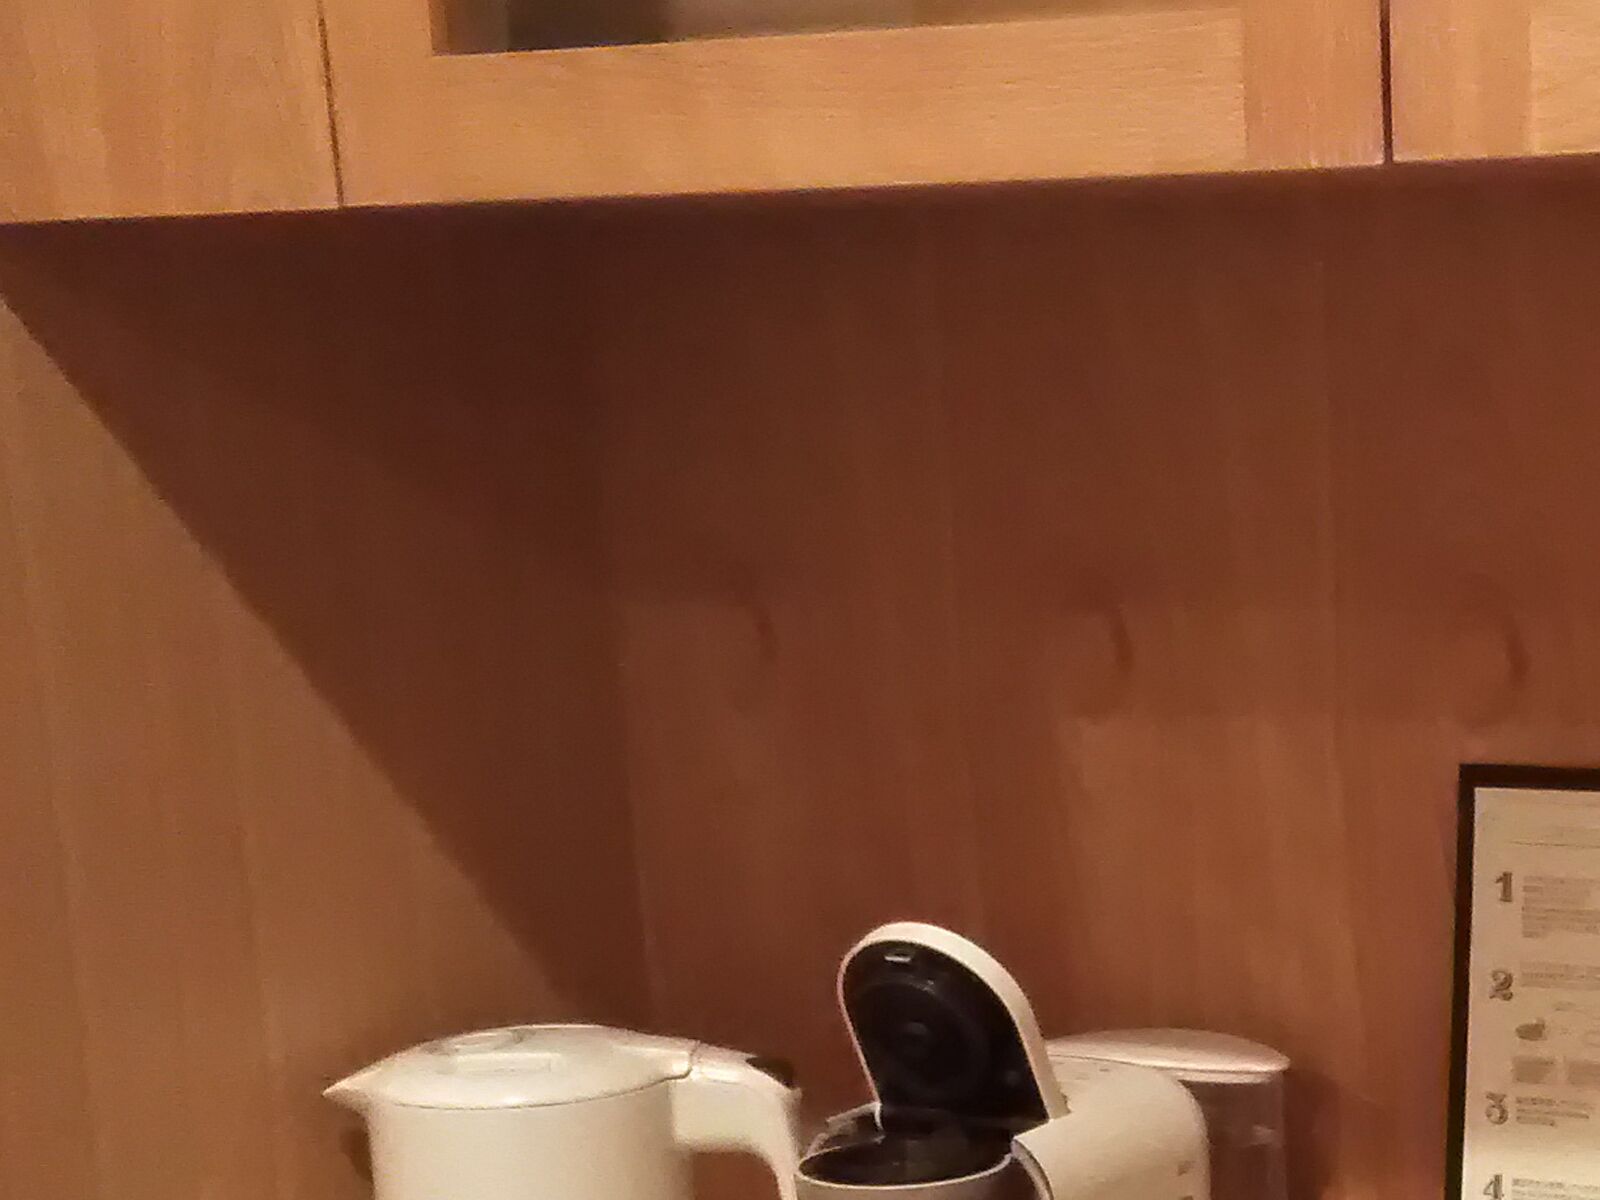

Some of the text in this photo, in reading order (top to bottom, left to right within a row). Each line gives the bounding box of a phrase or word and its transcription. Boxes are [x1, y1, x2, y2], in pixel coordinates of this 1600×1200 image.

[1496, 871, 1513, 903] 1
[1489, 969, 1514, 1001] 2
[1485, 1092, 1509, 1125] 3
